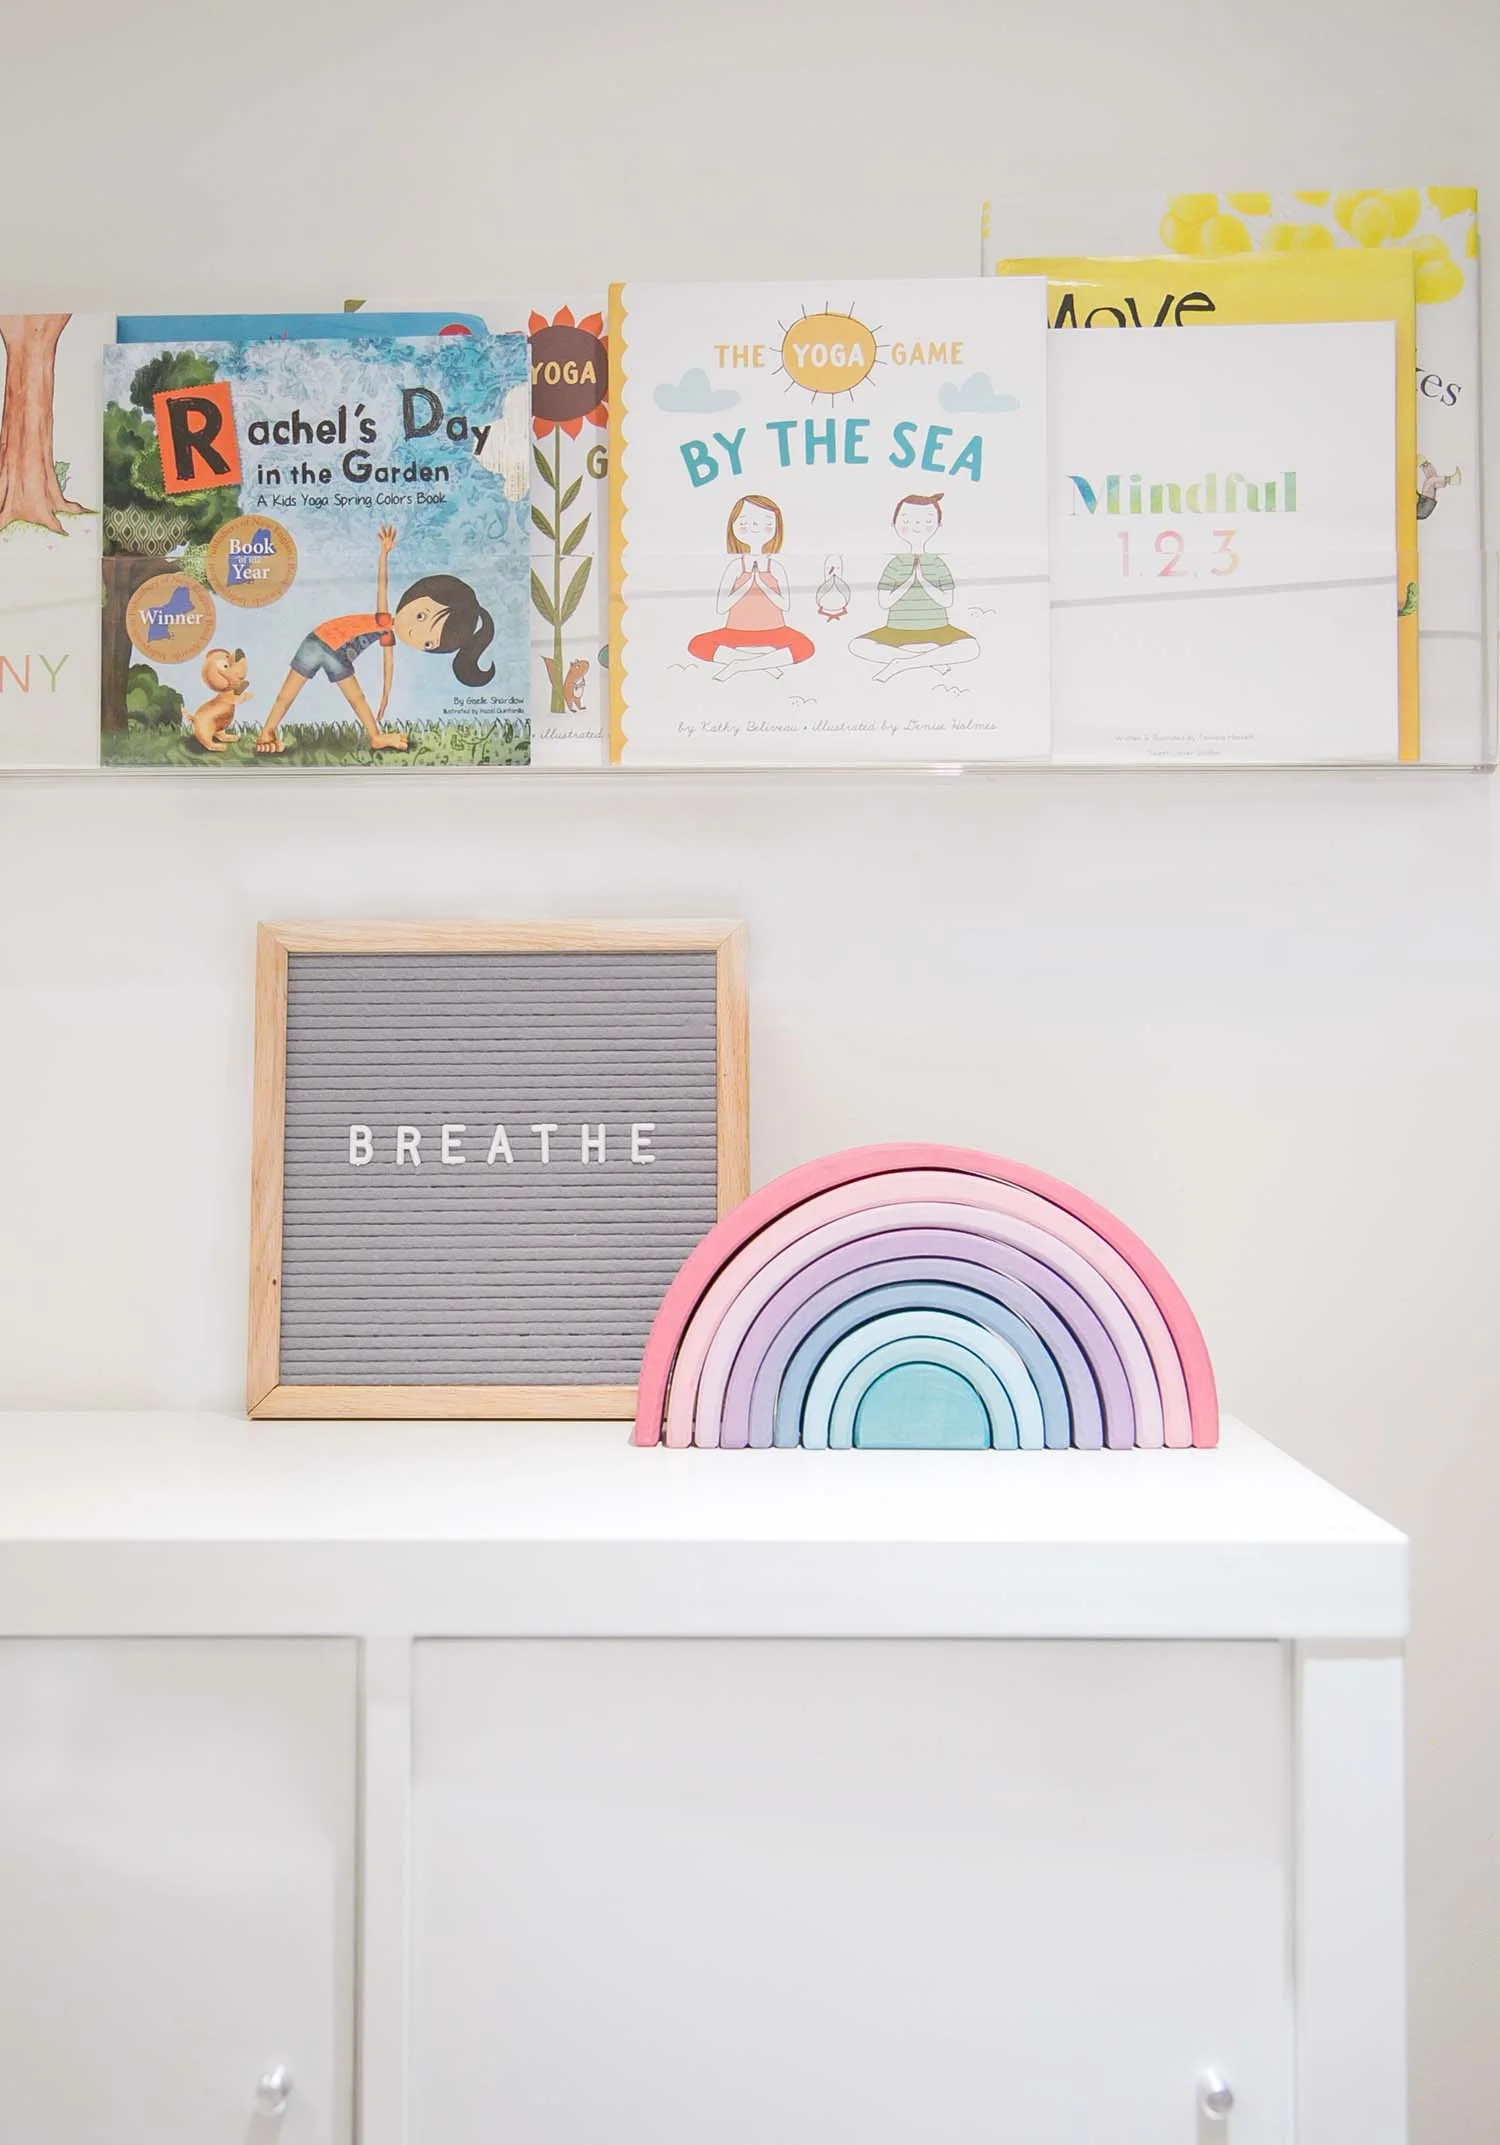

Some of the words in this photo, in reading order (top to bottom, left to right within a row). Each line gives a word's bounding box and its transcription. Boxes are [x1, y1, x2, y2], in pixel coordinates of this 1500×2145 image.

[713, 344, 766, 369] THE
[791, 343, 865, 368] YOGA
[891, 341, 965, 366] GAME
[532, 360, 597, 385] YOGA
[166, 396, 377, 480] Rachel's
[401, 387, 491, 455] Day
[679, 427, 746, 488] BY
[766, 418, 870, 468] THE
[888, 421, 983, 483] SEA
[257, 464, 281, 485] in
[290, 462, 332, 485] the
[342, 449, 450, 485] Garden
[257, 494, 267, 507] A
[272, 494, 297, 507] Kids
[301, 494, 329, 509] Yoga
[334, 493, 373, 509] Spring
[375, 493, 413, 506] Colors
[416, 491, 447, 505] Book
[1066, 471, 1298, 516] Mindful
[229, 538, 275, 555] Book
[232, 564, 271, 580] Year
[139, 610, 204, 625] Winner
[453, 696, 465, 706] By
[678, 721, 696, 737] by
[700, 720, 740, 737] Kathy
[811, 719, 877, 732] illustrated
[881, 720, 898, 735] by
[952, 718, 998, 731] Holmes
[349, 1123, 656, 1166] BREATHE
